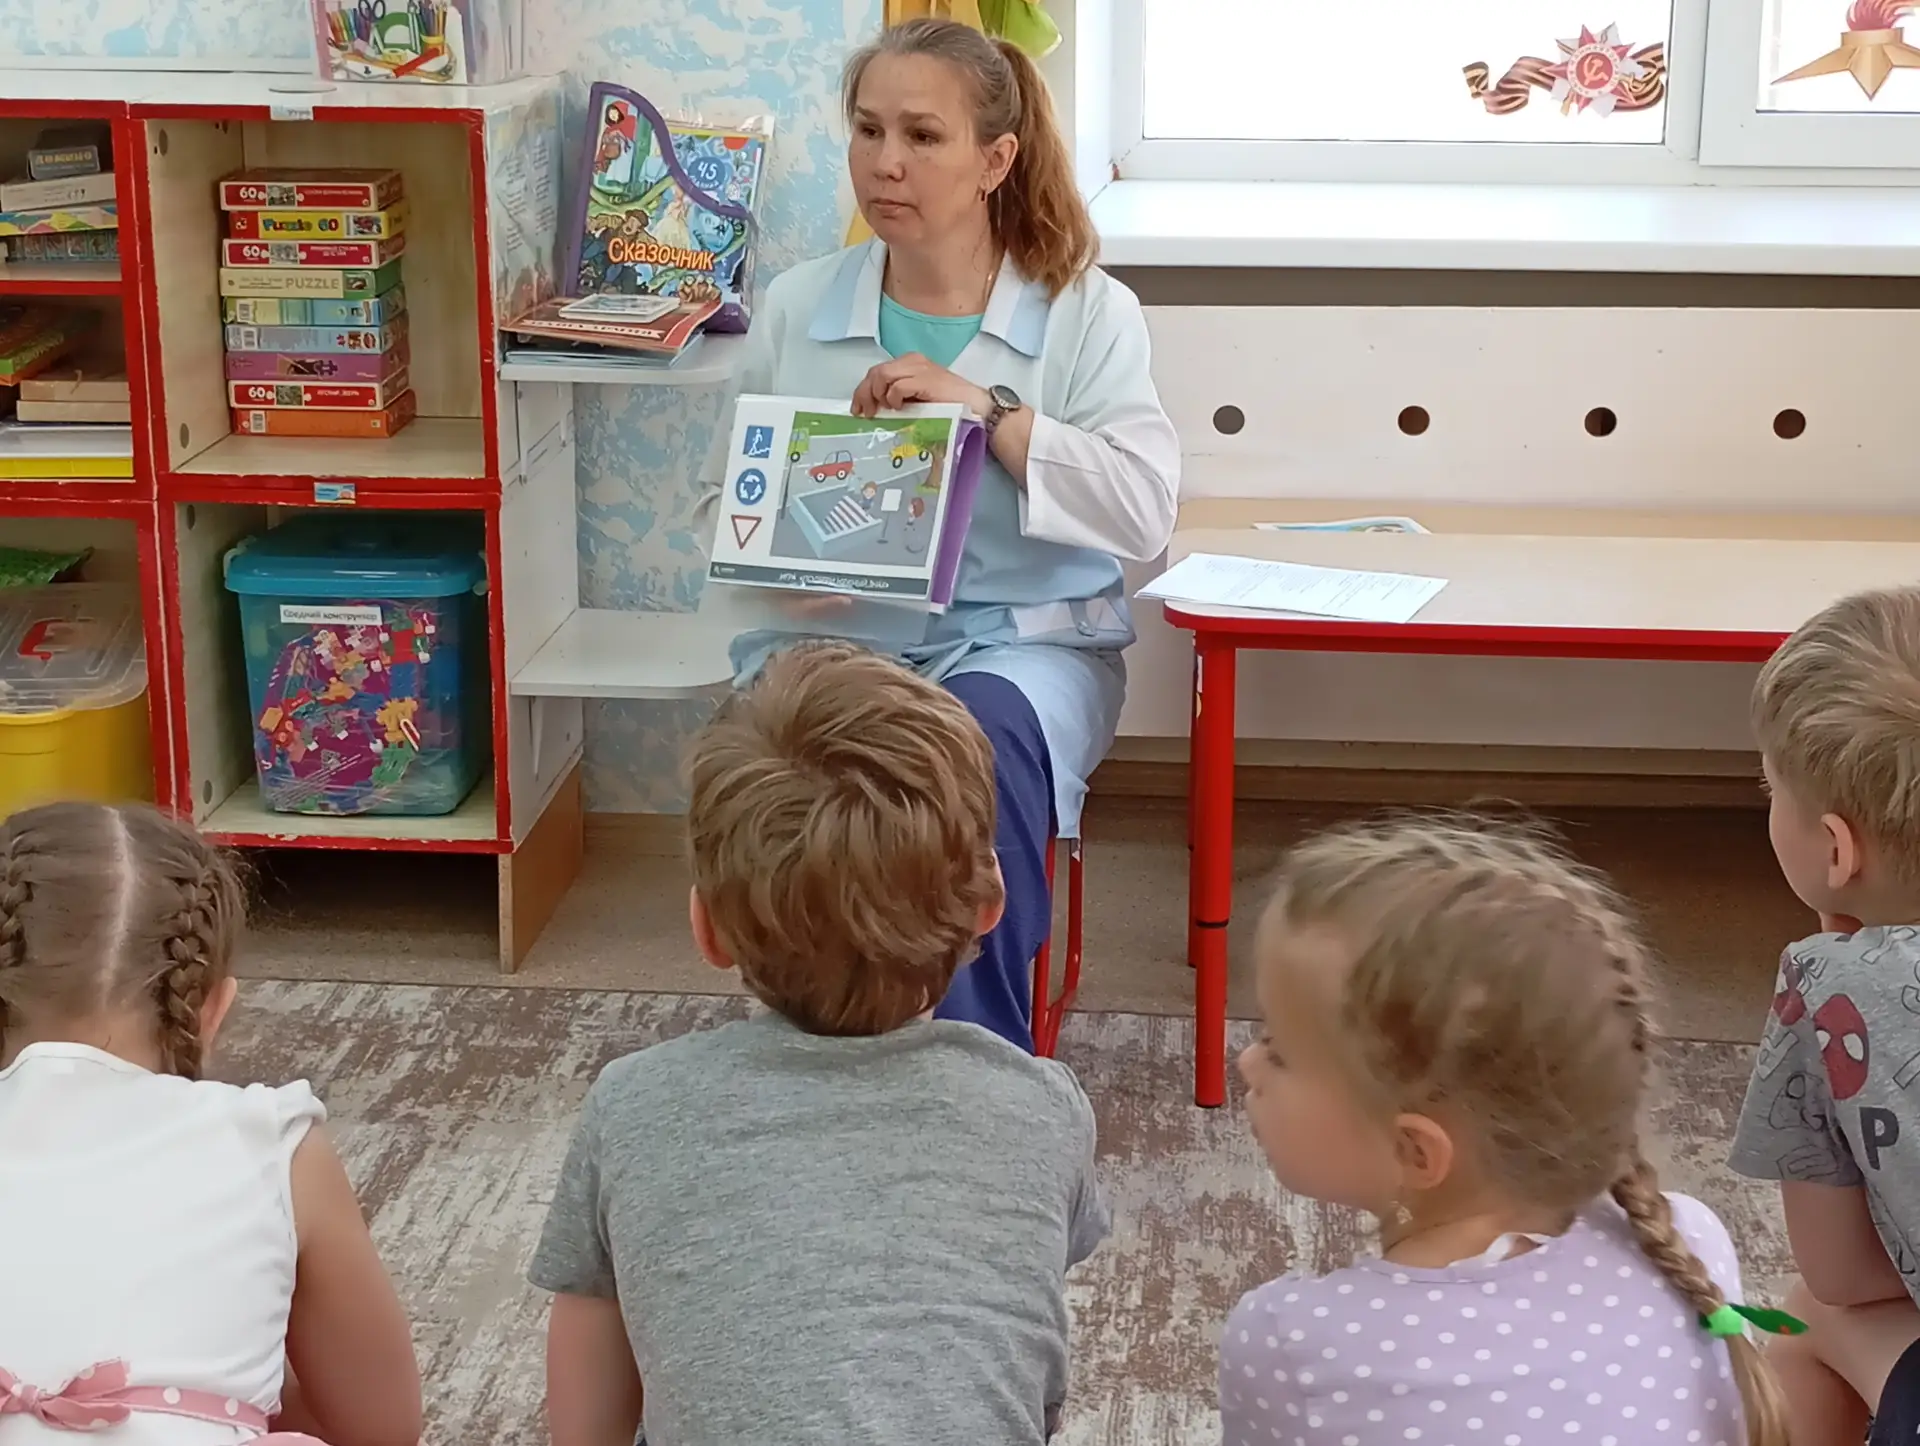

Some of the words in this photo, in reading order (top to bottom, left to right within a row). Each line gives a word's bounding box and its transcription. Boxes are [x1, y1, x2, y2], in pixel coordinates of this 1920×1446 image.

[697, 160, 717, 180] 45
[239, 186, 257, 199] 60
[318, 218, 339, 232] 60
[242, 245, 260, 258] 60
[608, 237, 715, 271] Сказочник
[285, 278, 340, 290] PUZZLE
[248, 386, 265, 399] 60
[1859, 1106, 1900, 1171] P
